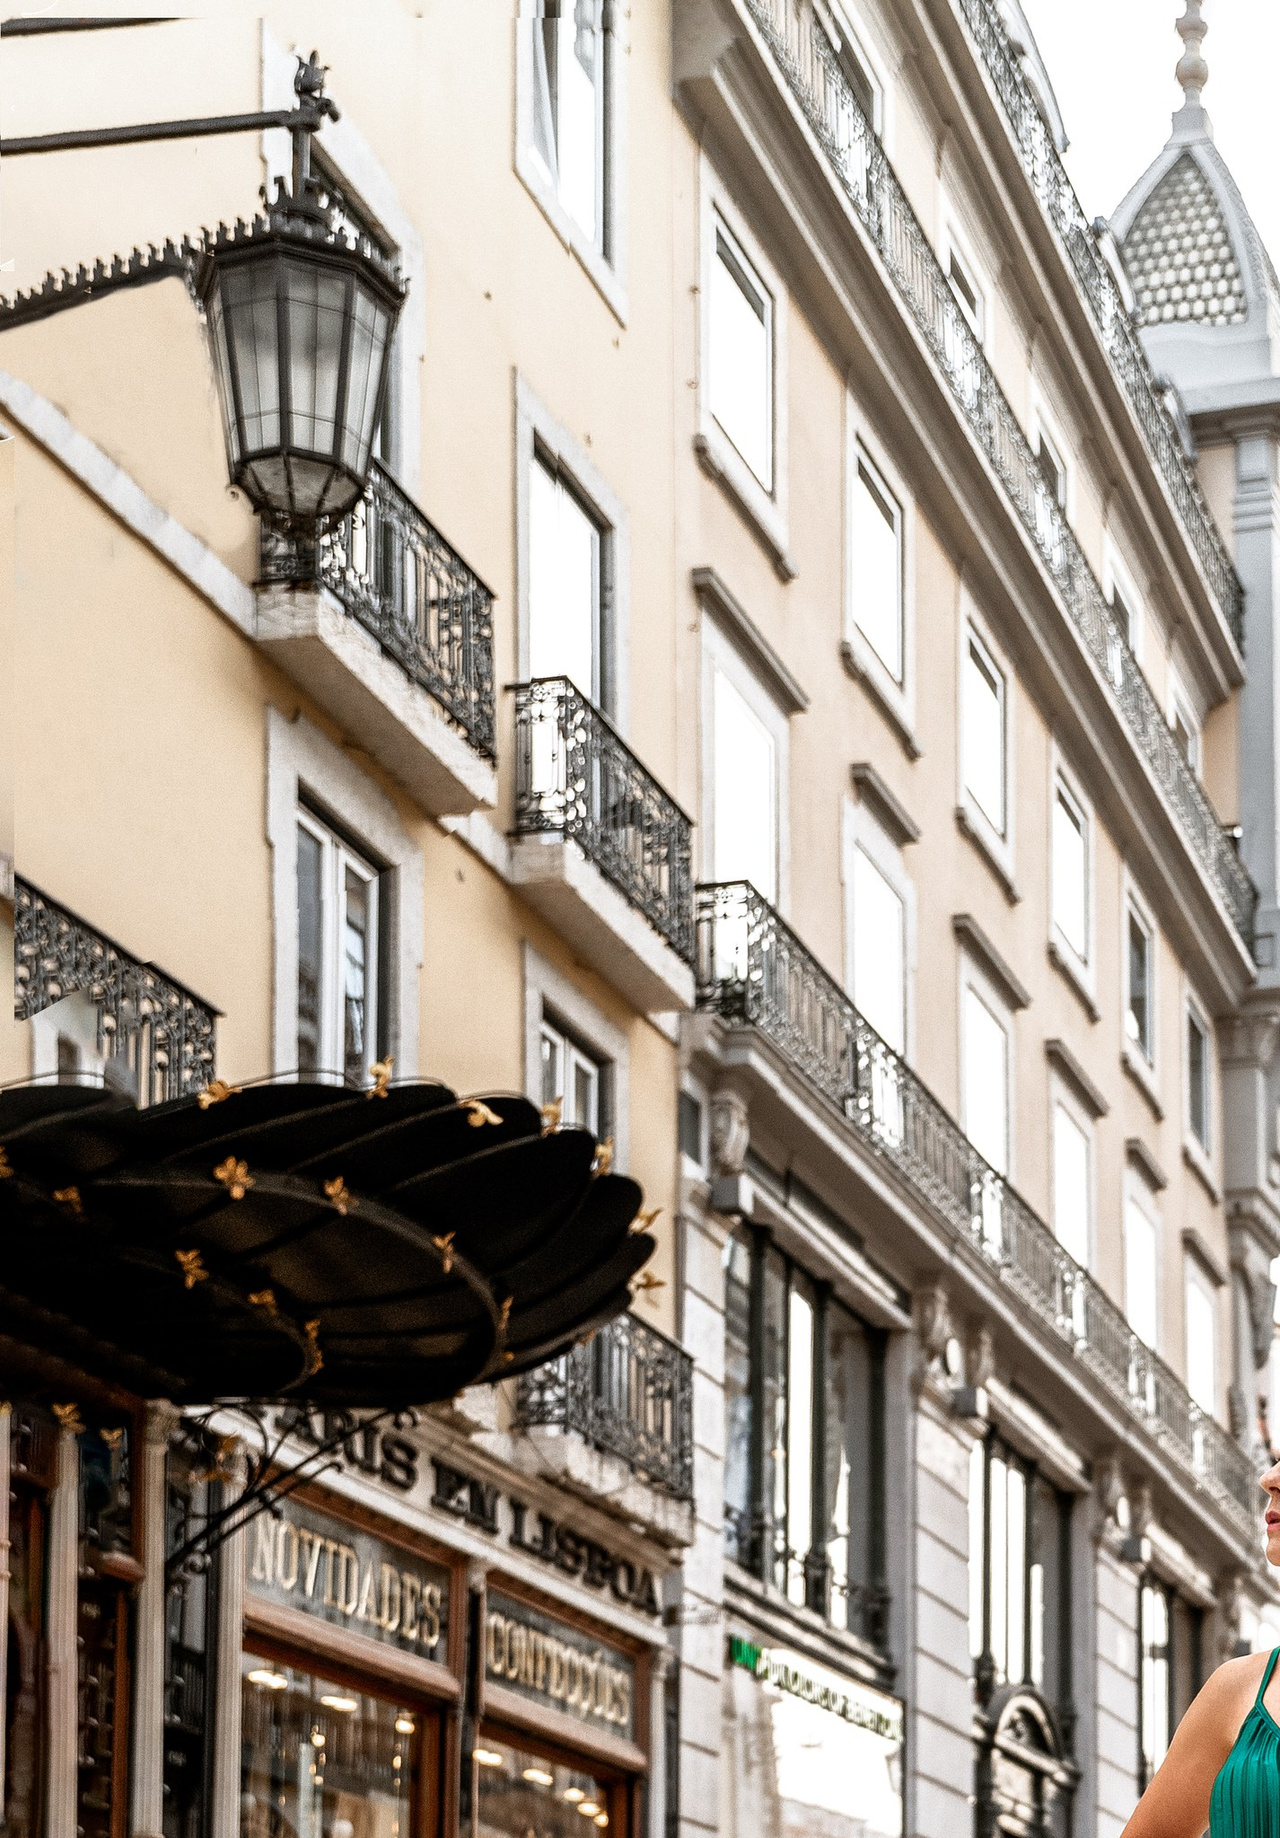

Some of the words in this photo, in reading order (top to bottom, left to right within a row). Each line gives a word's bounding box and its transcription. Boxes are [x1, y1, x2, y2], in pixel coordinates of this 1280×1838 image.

[252, 1511, 442, 1648] NOVIDADES
[256, 1403, 419, 1491] ARIS
[430, 1454, 501, 1534] EM
[508, 1497, 661, 1616] LISBOA
